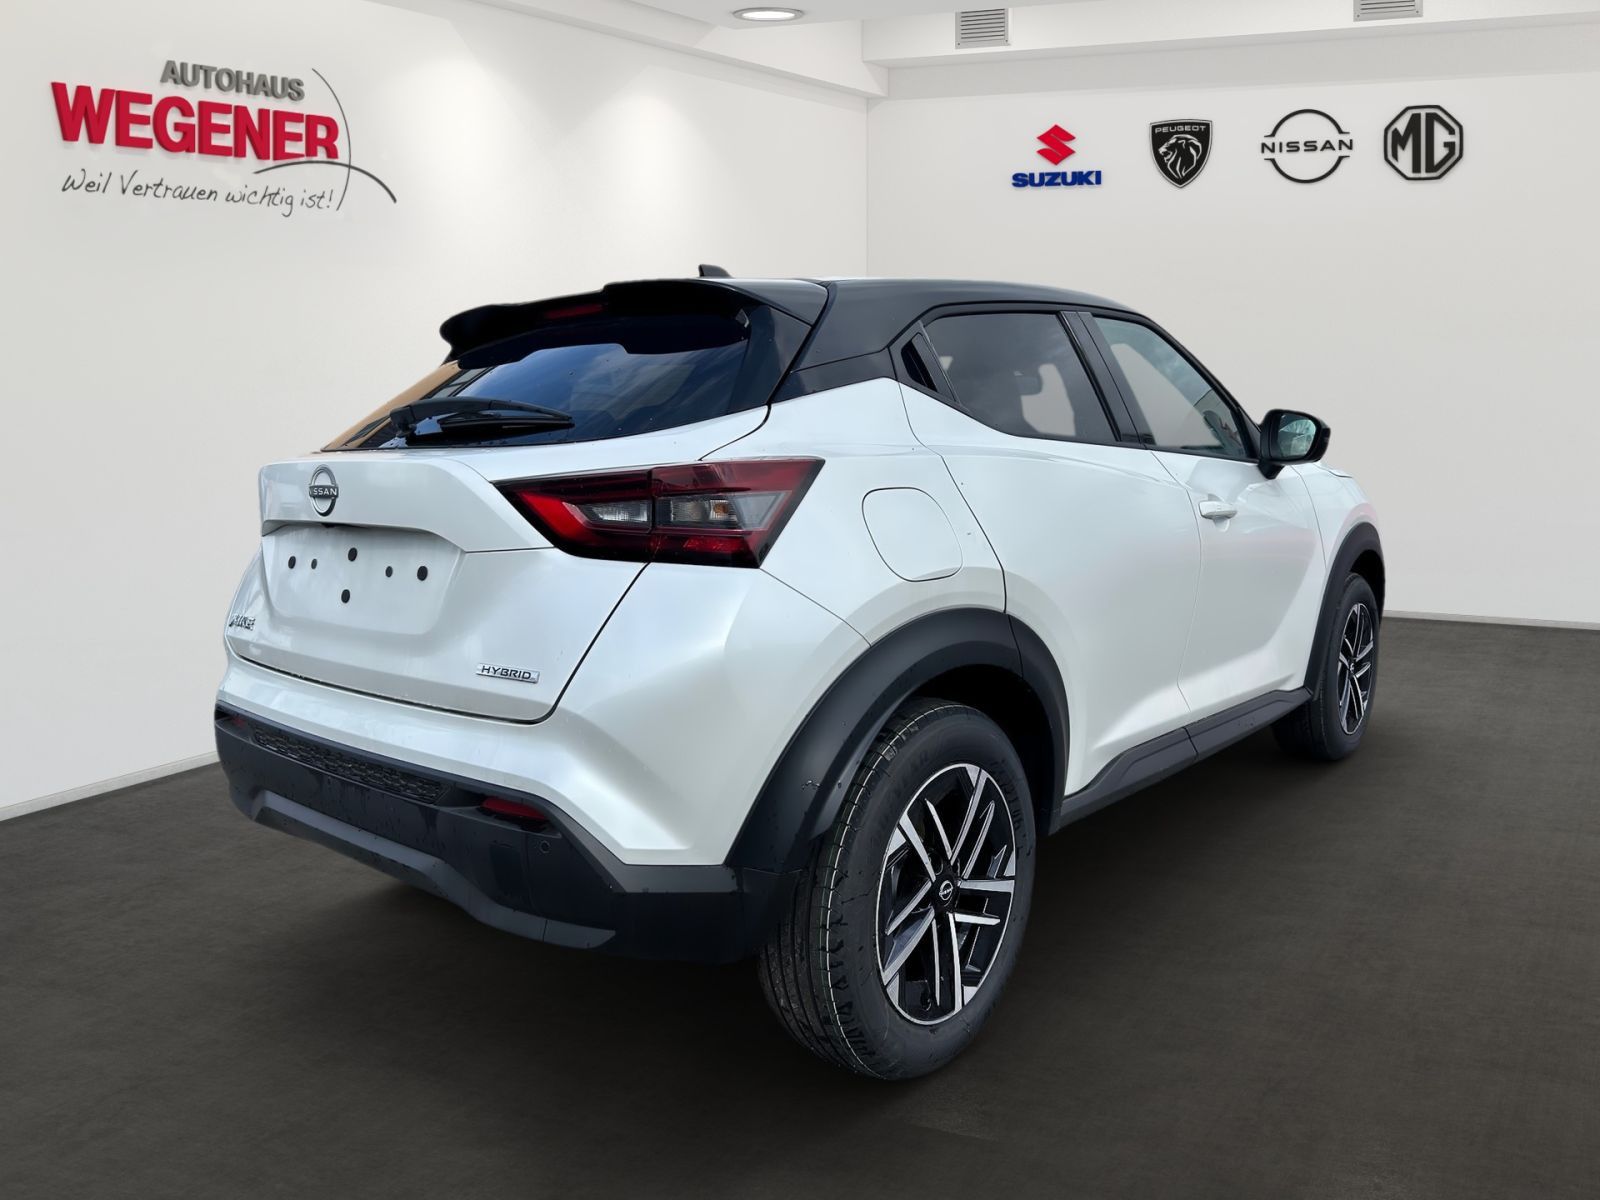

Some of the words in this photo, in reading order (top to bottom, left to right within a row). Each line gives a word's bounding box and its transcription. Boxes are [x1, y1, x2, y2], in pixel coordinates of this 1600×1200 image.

[160, 60, 305, 101] AUTOHAUS
[51, 82, 340, 162] WEGENER
[1154, 125, 1207, 134] PEUGEOT
[1261, 138, 1354, 154] NISSAN
[1391, 112, 1456, 173] MG
[61, 168, 112, 194] Weil
[120, 169, 218, 202] Vertrauen
[225, 184, 294, 218] wichtig
[300, 189, 334, 210] ist!
[1012, 170, 1102, 188] SUZUKI
[481, 665, 532, 680] HYBRID
